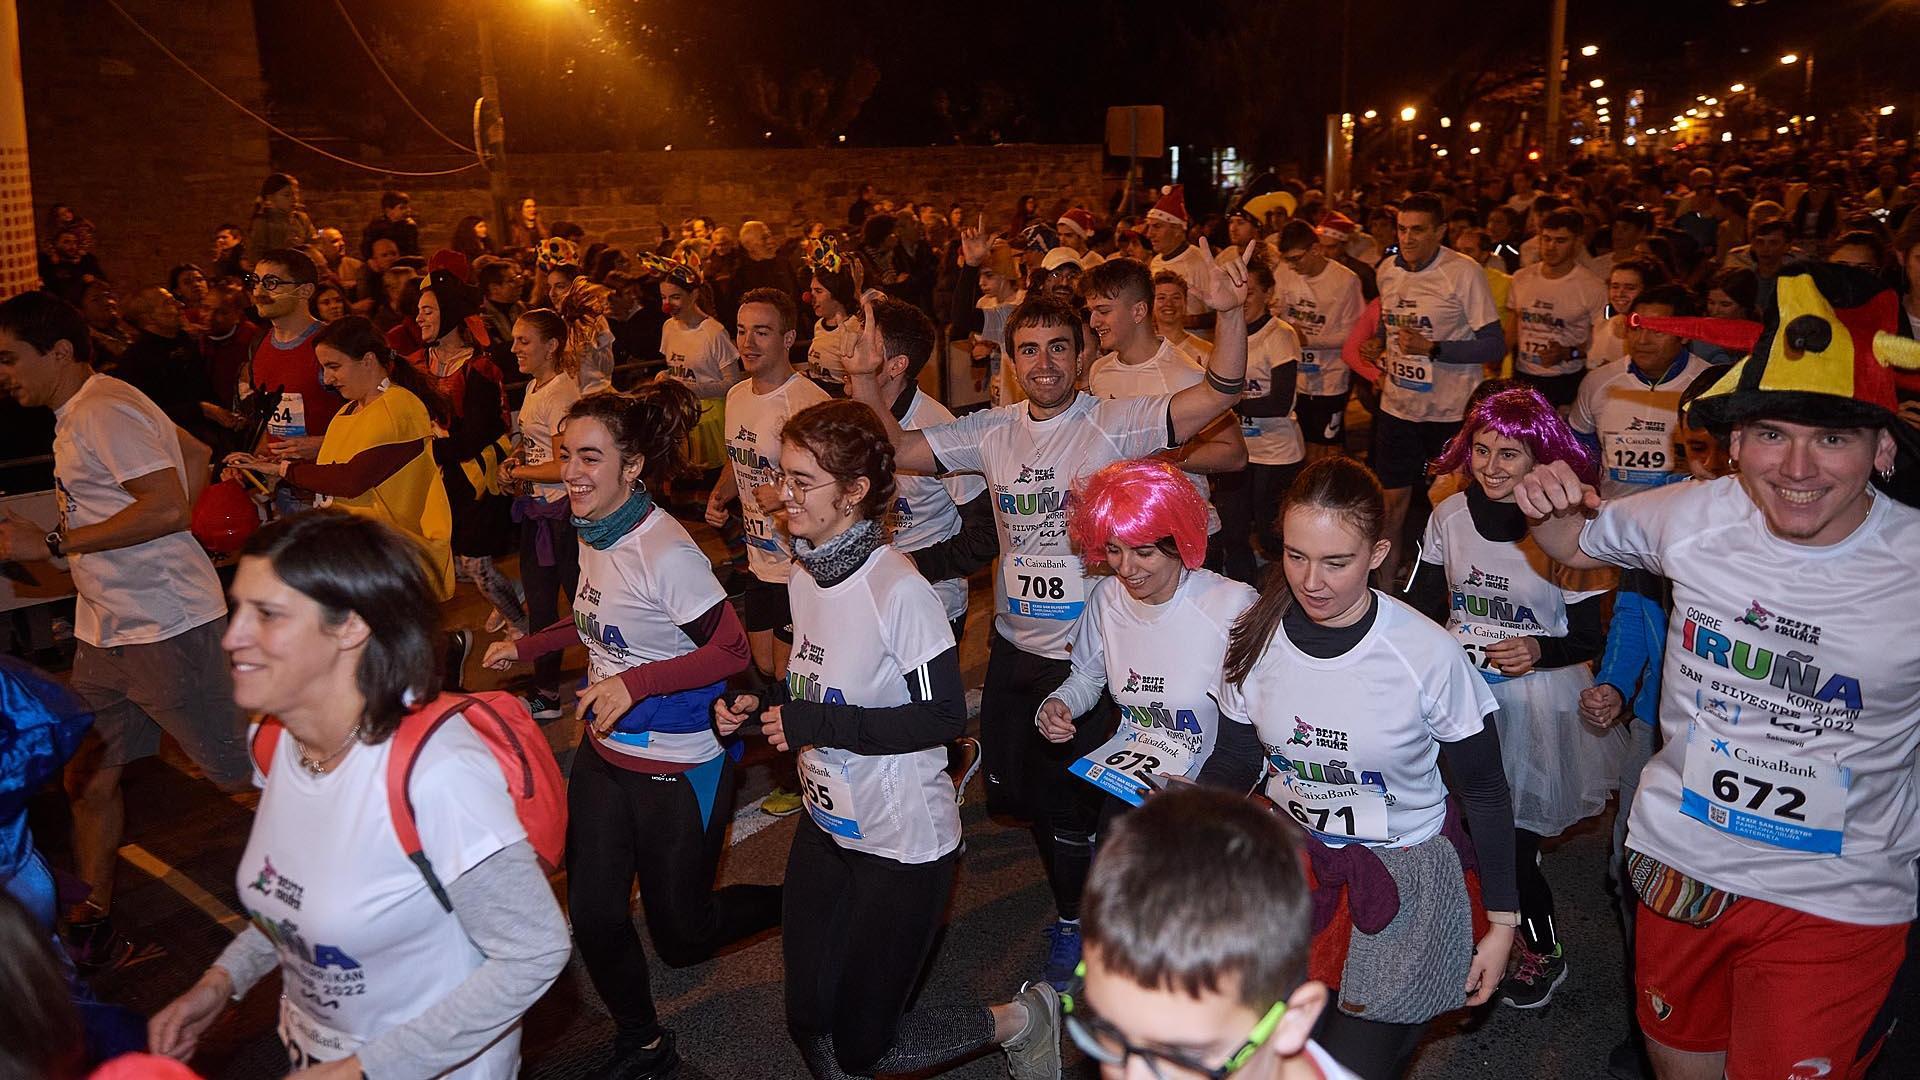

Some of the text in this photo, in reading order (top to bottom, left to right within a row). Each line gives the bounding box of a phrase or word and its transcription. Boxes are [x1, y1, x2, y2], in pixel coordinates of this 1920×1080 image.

[1392, 362, 1425, 380] 1350
[726, 445, 772, 471] RUÑA
[1614, 450, 1665, 468] 1249
[1025, 558, 1067, 569] CaixaBank
[1018, 575, 1065, 600] 708
[1451, 590, 1539, 625] RUÑA
[1686, 606, 1722, 631] CORRE
[1682, 618, 1864, 711] IRUÑA
[1680, 664, 1855, 733] SAN SILVESTRE 2022
[1786, 692, 1860, 720] KORRIKAN
[1137, 732, 1180, 758] CaixaBank
[1315, 727, 1348, 741] BESTE
[1105, 750, 1161, 774] 673
[1734, 747, 1817, 779] CaixaBank
[802, 774, 834, 812] 55
[1294, 785, 1359, 800] CaixaBank
[1712, 769, 1807, 822] 672
[1288, 800, 1355, 836] 671
[324, 983, 366, 997] 2022
